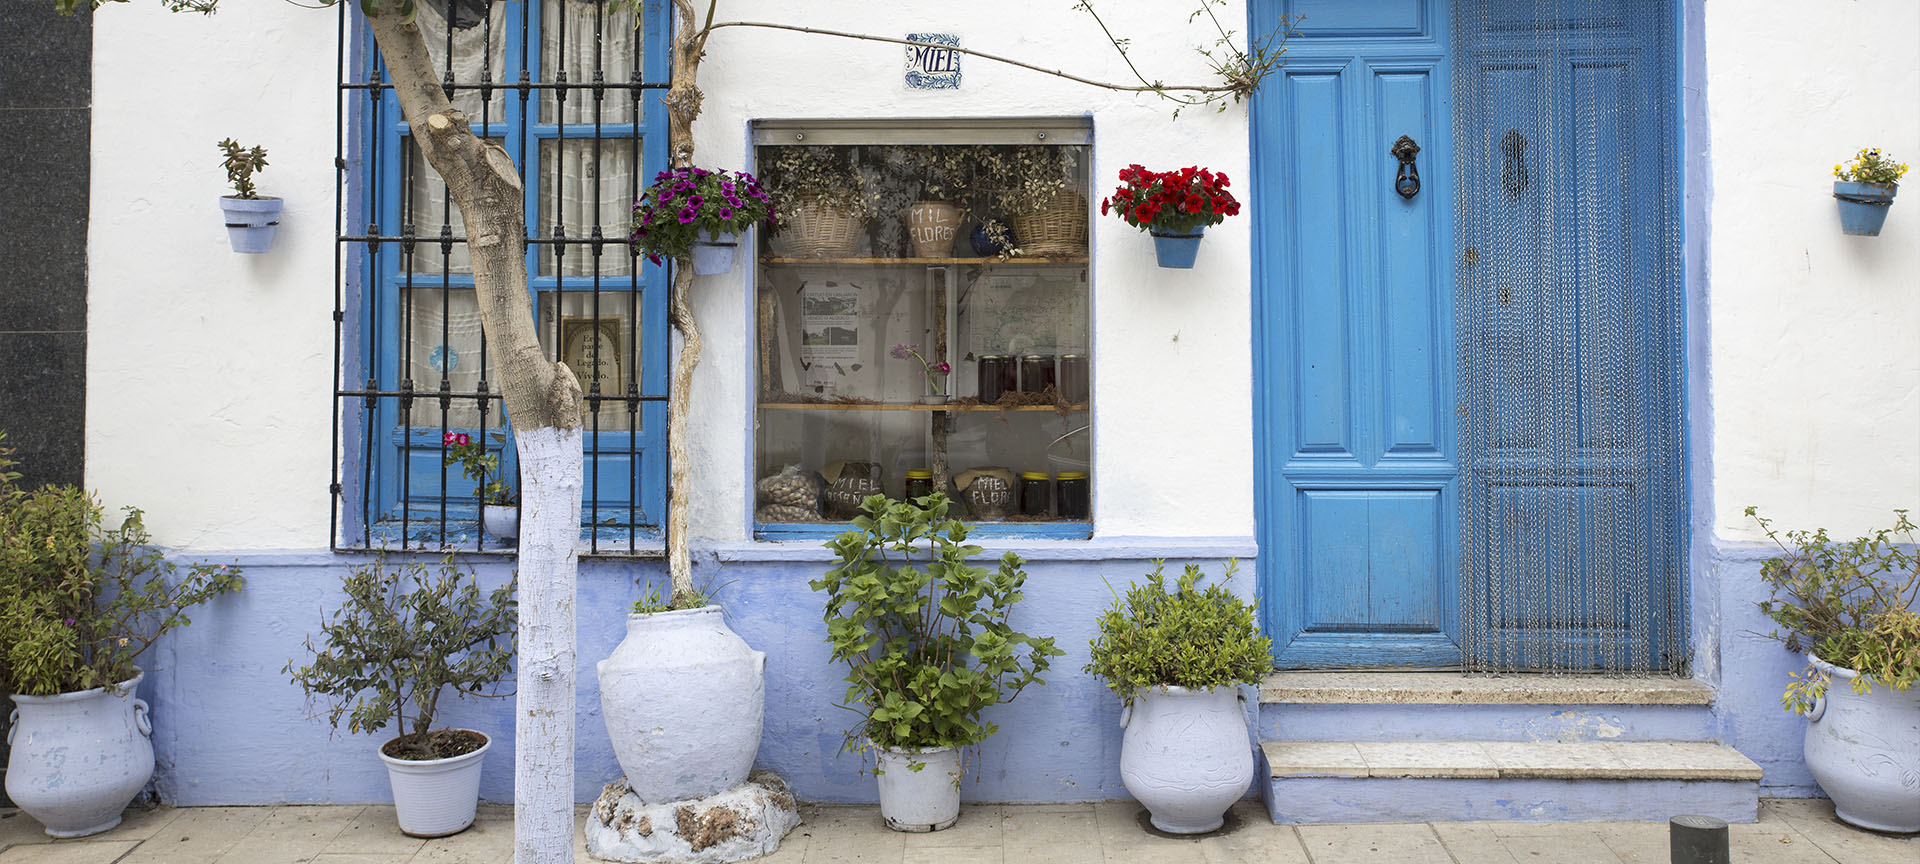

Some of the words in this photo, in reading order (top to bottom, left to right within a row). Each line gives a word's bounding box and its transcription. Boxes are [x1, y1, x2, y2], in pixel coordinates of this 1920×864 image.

[912, 44, 956, 75] MIEL
[911, 208, 949, 224] MIL
[910, 225, 955, 243] FLORES
[583, 334, 602, 342] Ers
[577, 358, 609, 368] Legdo.
[832, 477, 881, 491] MIEL
[977, 476, 1007, 490] MIEL
